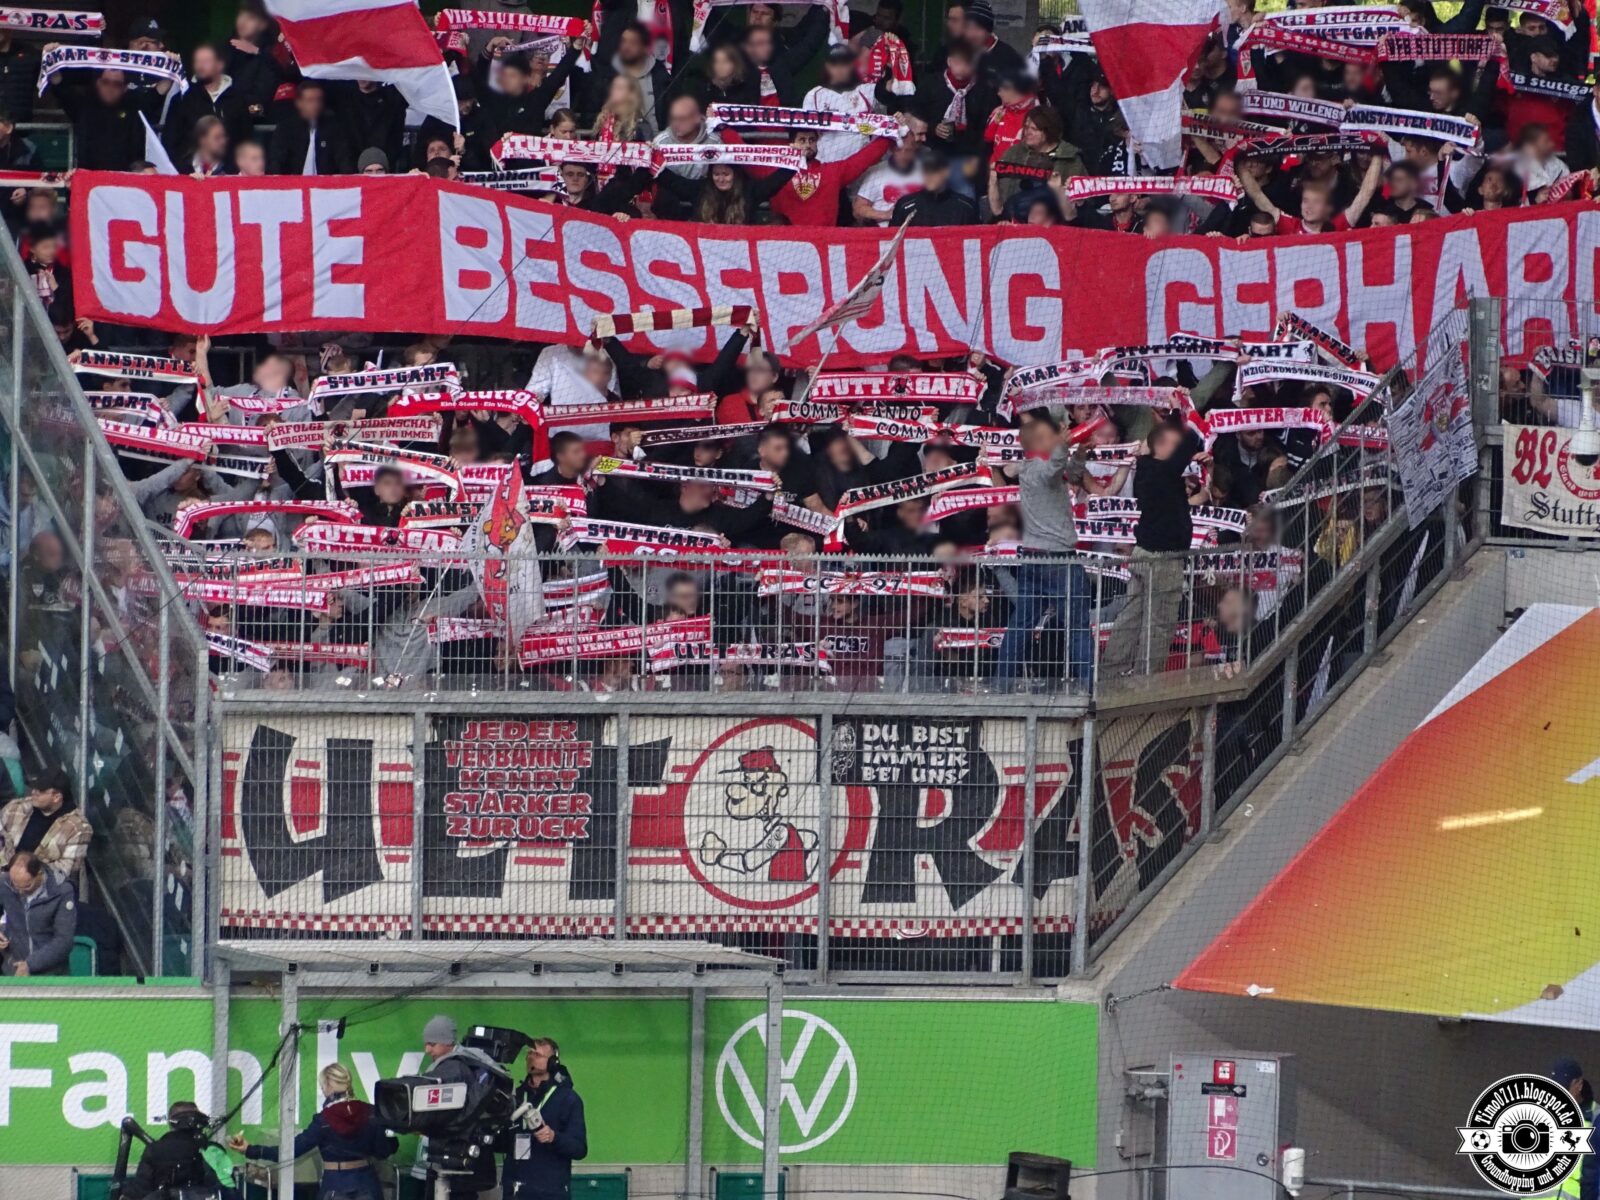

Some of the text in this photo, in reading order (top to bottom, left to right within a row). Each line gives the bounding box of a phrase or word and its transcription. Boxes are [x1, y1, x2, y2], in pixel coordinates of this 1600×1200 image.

[477, 12, 573, 30] STUTTGART
[1263, 96, 1285, 110] UND
[1430, 121, 1474, 138] KURVE
[734, 156, 748, 164] IST
[86, 184, 365, 324] GUTE
[121, 367, 154, 378] KURVE
[327, 366, 450, 389] STUTTGART
[1272, 366, 1330, 378] KONSTANTE
[1332, 372, 1354, 384] SIND
[1357, 377, 1375, 389] WIR
[273, 433, 324, 447] VERGEHEN
[361, 430, 377, 439] IST
[400, 430, 434, 439] IMMER
[876, 422, 929, 440] COMM
[587, 522, 714, 547] STUTTGART
[802, 578, 904, 591] CC 97
[461, 720, 578, 741] JEDER
[862, 723, 970, 745] DU BIST
[444, 740, 593, 768] VERBANNTE
[862, 743, 970, 767] IMMER
[459, 768, 580, 791] KEHRT
[861, 766, 970, 785] BEI UNS!
